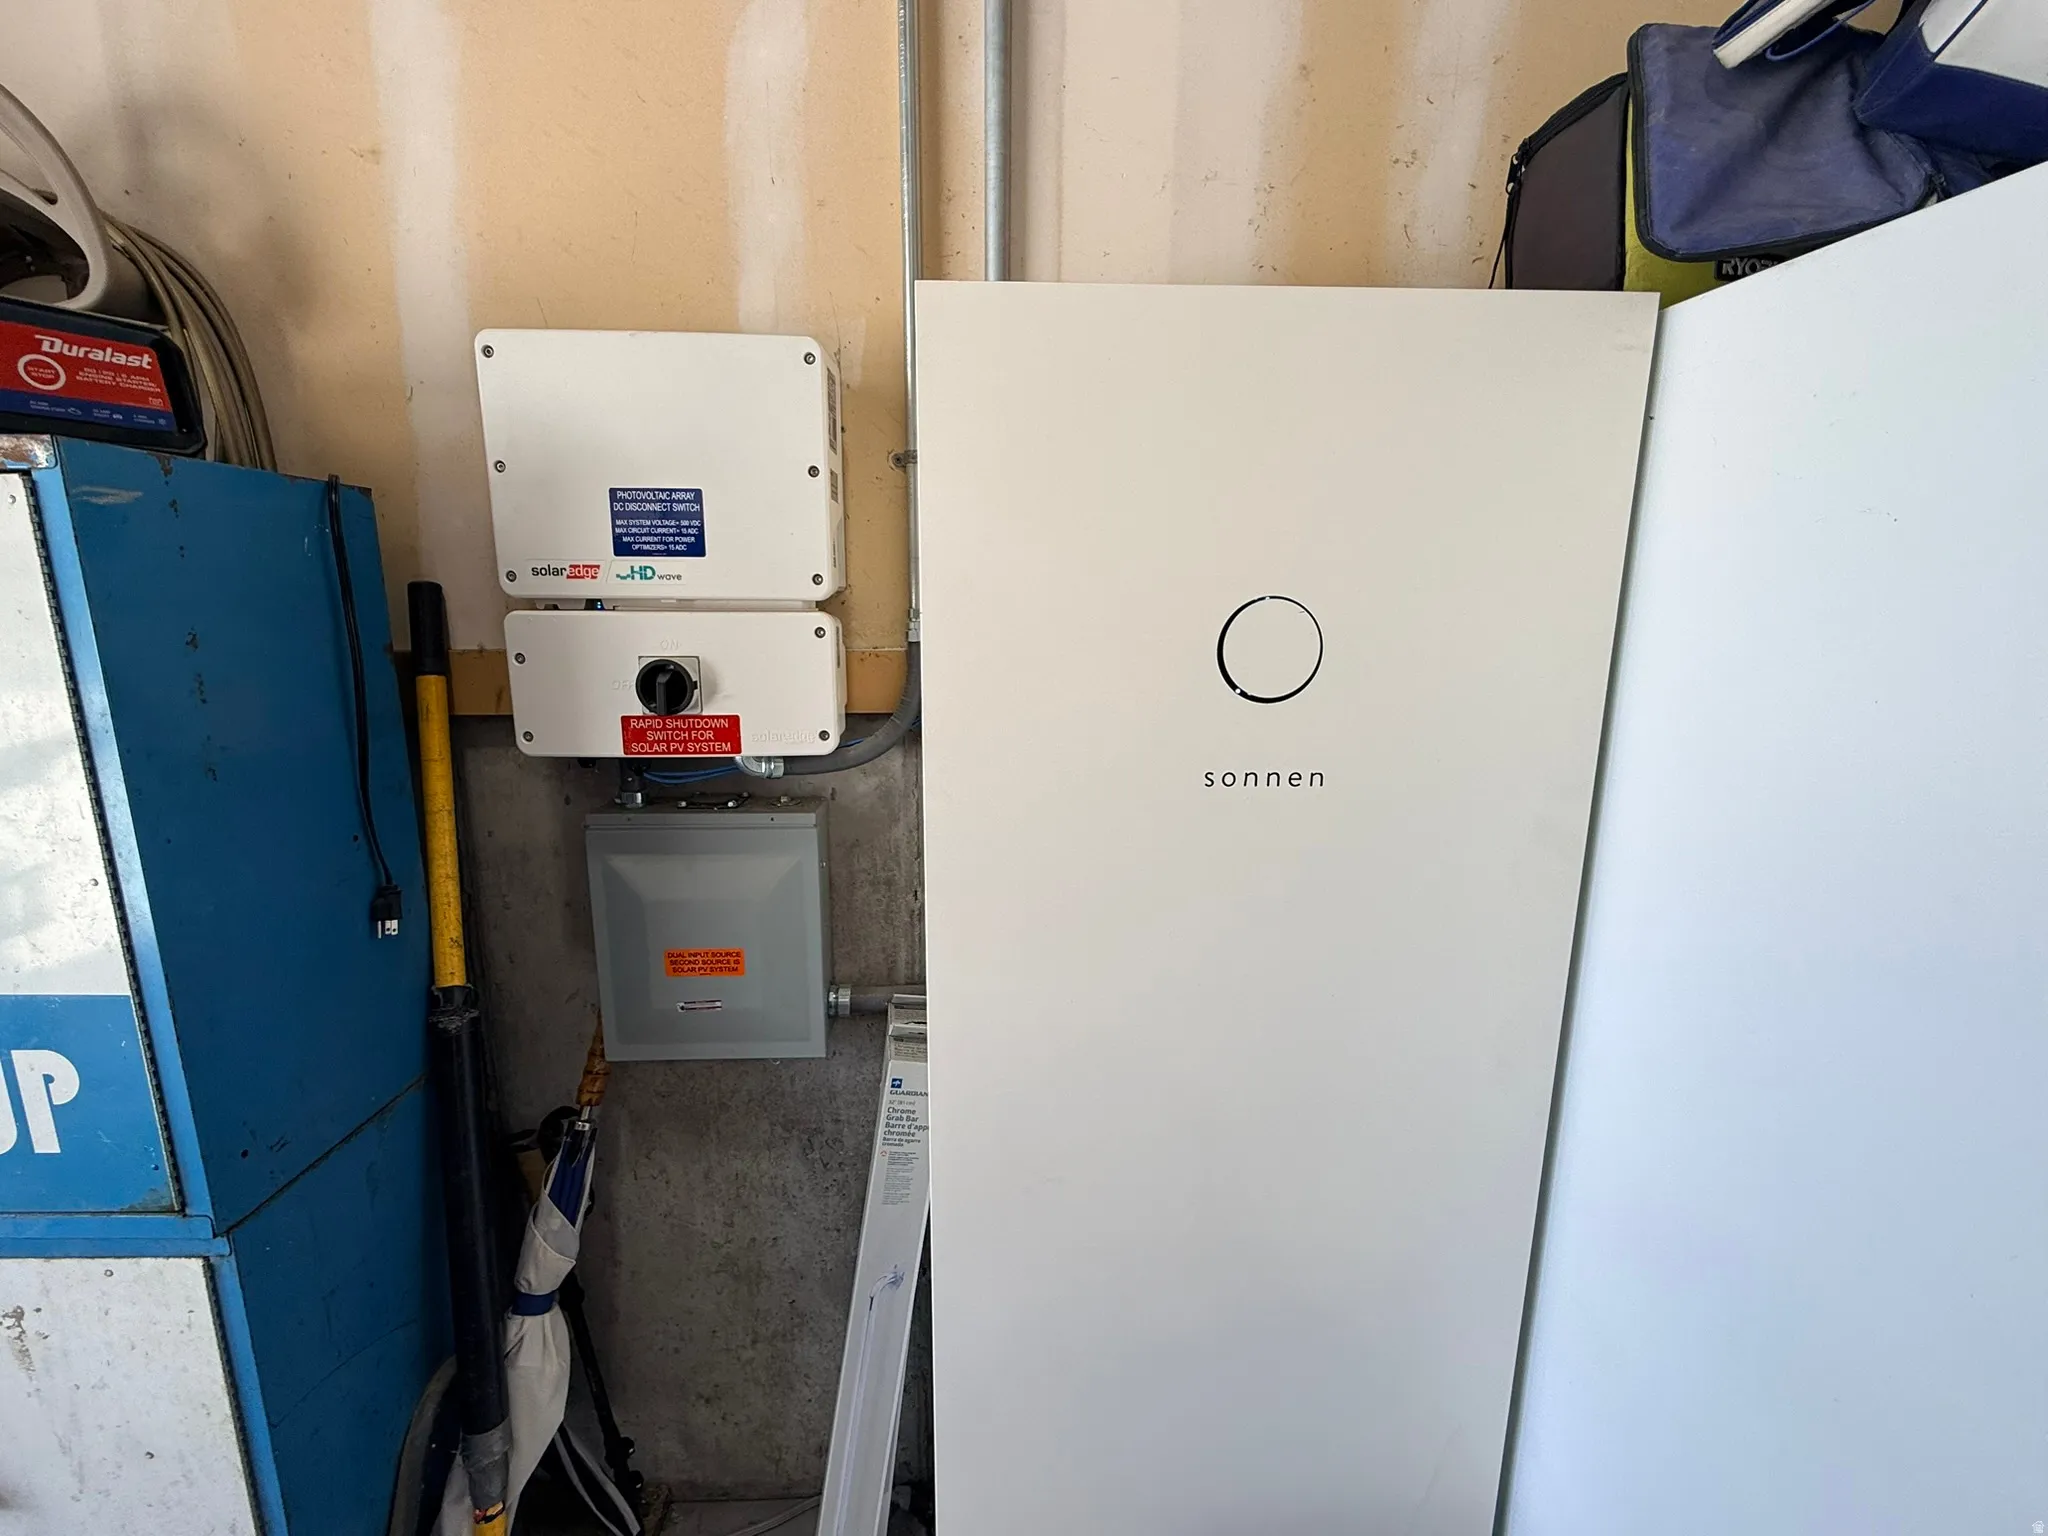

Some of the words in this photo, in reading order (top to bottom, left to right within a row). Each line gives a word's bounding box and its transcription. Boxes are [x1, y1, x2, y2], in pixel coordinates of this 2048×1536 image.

[34, 334, 152, 369] Duralast
[616, 490, 670, 500] PHOTOVOLTAIC
[671, 491, 695, 500] ARRAY
[613, 502, 624, 511] DC
[625, 502, 671, 512] DISCONNECT
[672, 503, 700, 512] SWITCH
[531, 564, 600, 579] solaredge
[630, 565, 656, 581] HD
[656, 572, 683, 581] wave
[660, 639, 680, 651] ON
[630, 719, 663, 729] RAPID
[665, 718, 729, 729] SHUTDOWN
[646, 731, 689, 741] SWITCH
[691, 730, 715, 740] FOR
[631, 742, 668, 753] SOLAR
[670, 742, 685, 752] PV
[686, 742, 731, 752] SYSTEM
[1204, 771, 1324, 788] sonnen
[889, 1089, 929, 1097] GUARDIAN
[887, 1106, 917, 1115] Chrome
[886, 1114, 905, 1122] Grab
[885, 1121, 906, 1130] Barre
[883, 1129, 916, 1138] chromée
